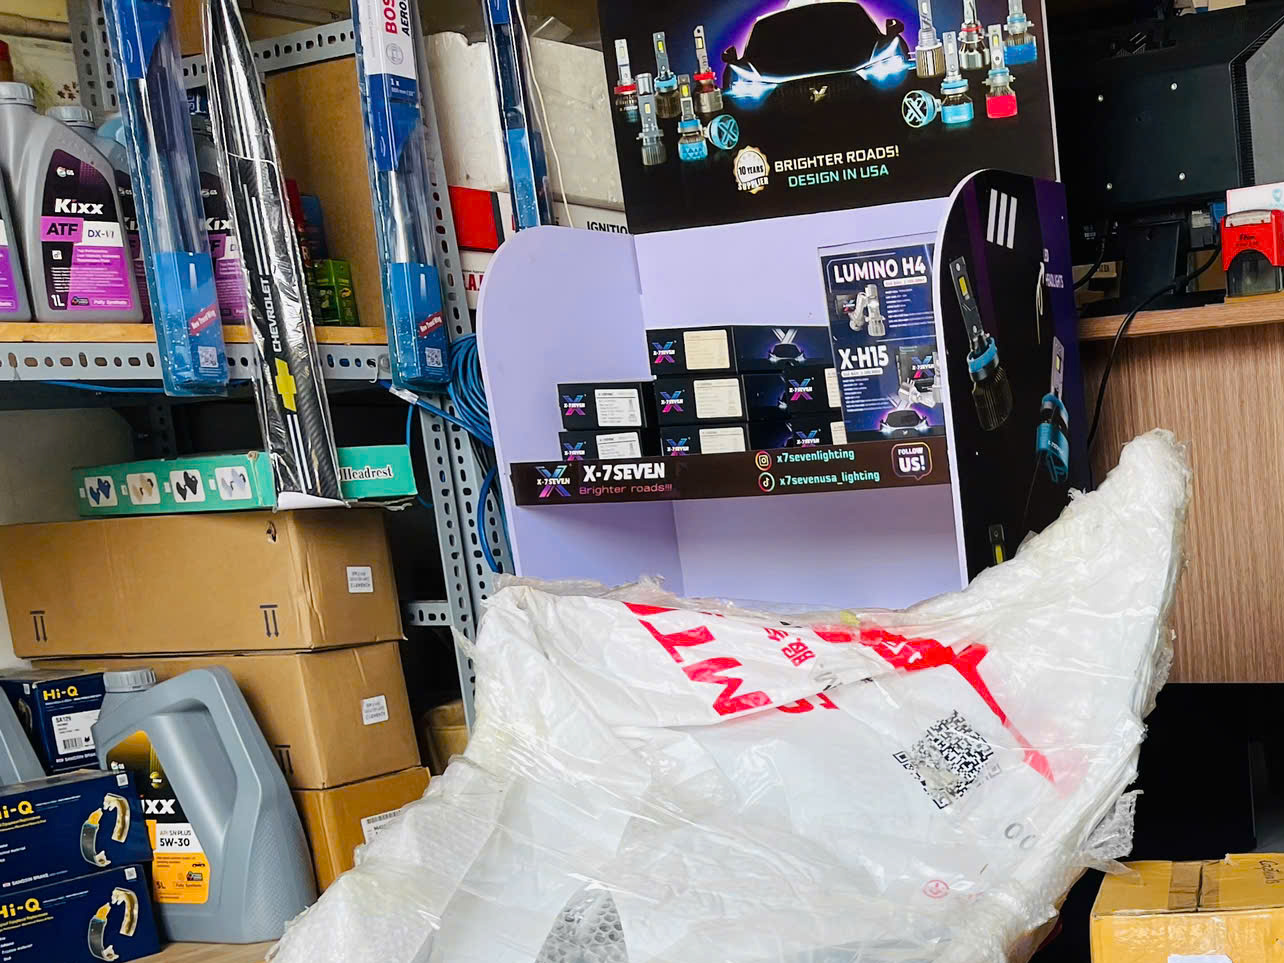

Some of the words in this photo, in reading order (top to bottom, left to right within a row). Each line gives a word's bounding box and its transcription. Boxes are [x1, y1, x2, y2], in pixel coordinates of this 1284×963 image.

[774, 152, 844, 173] BRIGHTER
[846, 144, 900, 163] ROADS!
[738, 164, 746, 176] 10
[747, 164, 764, 175] YEARS
[788, 170, 840, 188] DESIGN
[842, 167, 858, 181] IN
[860, 164, 889, 179] USA
[736, 176, 769, 191] SUPPLIER
[55, 198, 104, 215] Kixx
[46, 222, 79, 236] ATF
[833, 258, 899, 284] LUMINO
[901, 255, 926, 276] H4
[51, 294, 66, 307] 1L
[259, 277, 282, 353] CHEVROLET
[838, 344, 889, 370] X-H15
[776, 448, 855, 464] x7sevenlighting
[897, 446, 924, 456] FOLLOW
[897, 455, 926, 473] US!
[339, 465, 393, 482] Headrest
[582, 462, 666, 483] X-7SEVEN
[779, 470, 881, 487] x7sevenusa_lighting
[536, 477, 571, 486] X-7SEVEN
[579, 485, 626, 497] Brighter
[630, 483, 673, 493] roads!!!
[43, 685, 79, 701] Hi-Q
[160, 838, 190, 847] 5W-30
